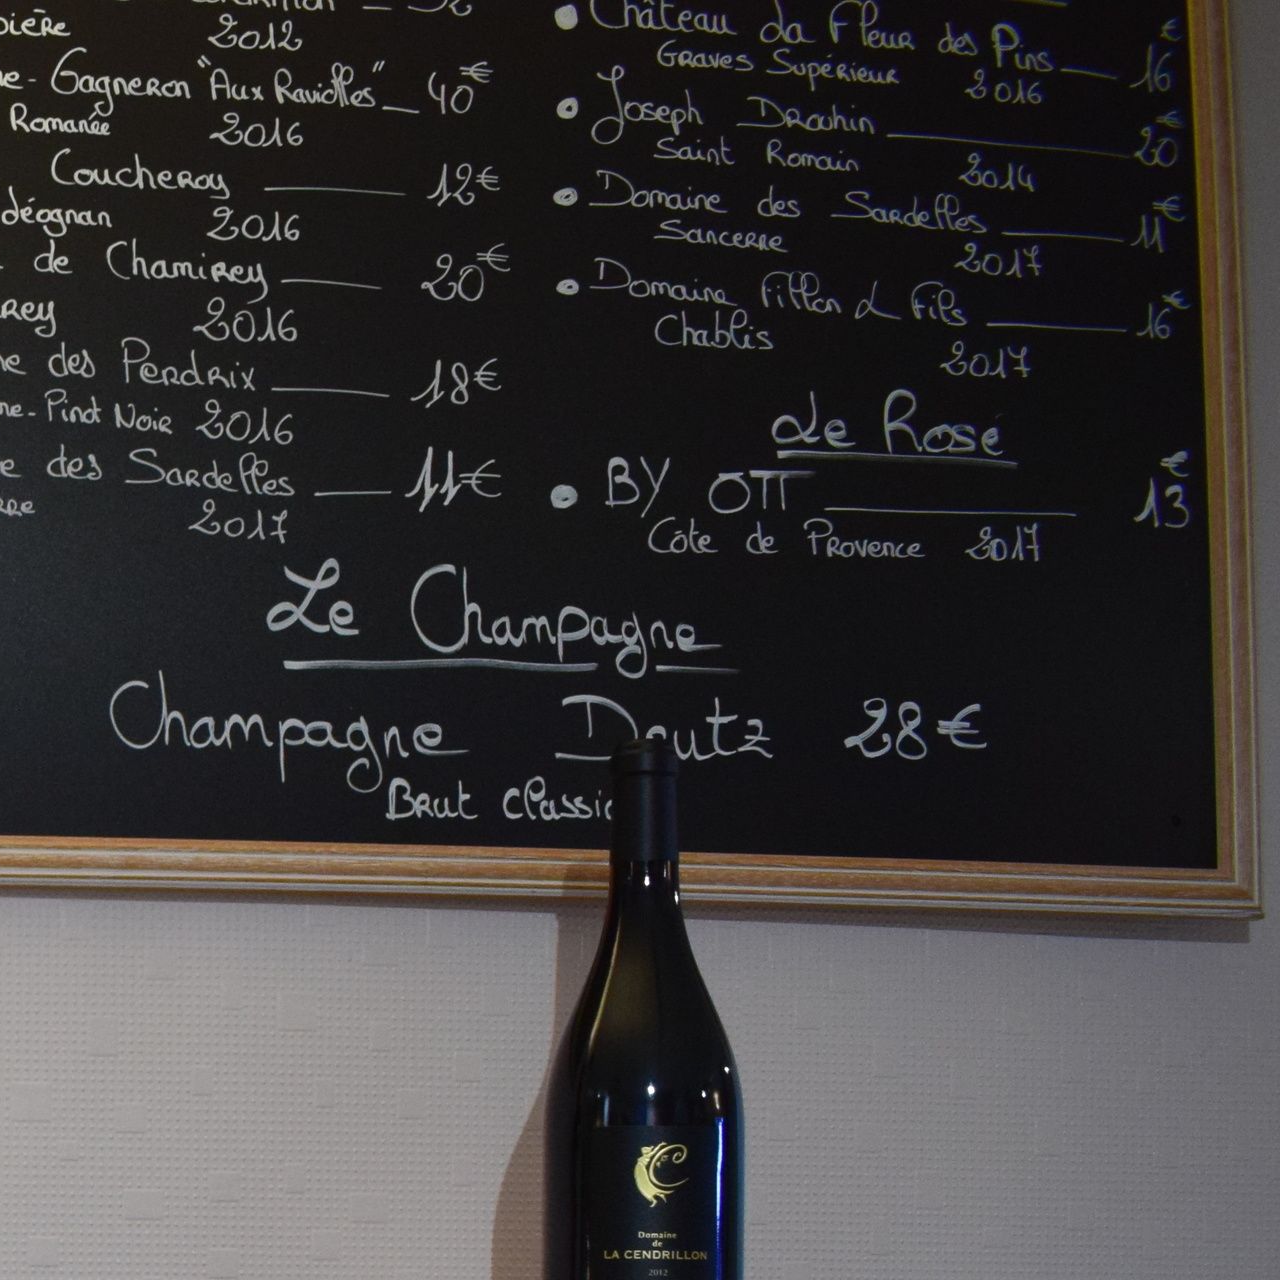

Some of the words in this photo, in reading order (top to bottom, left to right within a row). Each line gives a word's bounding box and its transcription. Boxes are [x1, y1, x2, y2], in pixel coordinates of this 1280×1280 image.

[207, 13, 302, 50] 2012
[939, 22, 978, 56] des
[992, 24, 1055, 72] Pins
[657, 40, 755, 68] Graves
[965, 69, 1042, 104] 2016
[209, 113, 303, 146] 2016
[591, 65, 704, 145] Joseph
[737, 96, 875, 135] Drouhin
[51, 148, 230, 199] Coucheroy
[427, 164, 500, 207] 12€
[654, 136, 735, 165] Saint
[766, 139, 859, 172] Romain
[959, 153, 1037, 192] 2014
[207, 206, 300, 241] 2016
[589, 170, 728, 214] Domaine
[757, 186, 801, 218] des
[830, 191, 988, 234] Sardelles
[34, 239, 72, 275] de
[107, 242, 268, 303] Chamirey
[653, 219, 788, 252] Sancerre
[956, 242, 1043, 280] 2017
[590, 257, 737, 307] Domaine
[911, 281, 968, 327] Fils
[193, 298, 298, 342] 2016
[653, 310, 775, 353] Chablis
[940, 341, 1032, 379] 2017
[48, 342, 96, 378] des
[121, 338, 256, 391] Perdrix
[115, 403, 173, 435] Noir
[196, 401, 294, 445] 2016
[47, 446, 102, 480] des
[125, 448, 296, 498] Sardelles
[605, 455, 670, 517] BY
[189, 501, 288, 543] 2017
[746, 522, 780, 556] de
[804, 518, 927, 559] Provence
[966, 523, 1042, 562] 2017
[266, 558, 360, 636] Le
[410, 563, 724, 678] Champagne
[109, 670, 470, 791] Champagne
[843, 697, 989, 760] 28€
[385, 777, 479, 820] Brut
[604, 1250, 620, 1259] LA
[624, 1250, 708, 1260] CENDRILLON
[638, 1231, 677, 1239] Domaine
